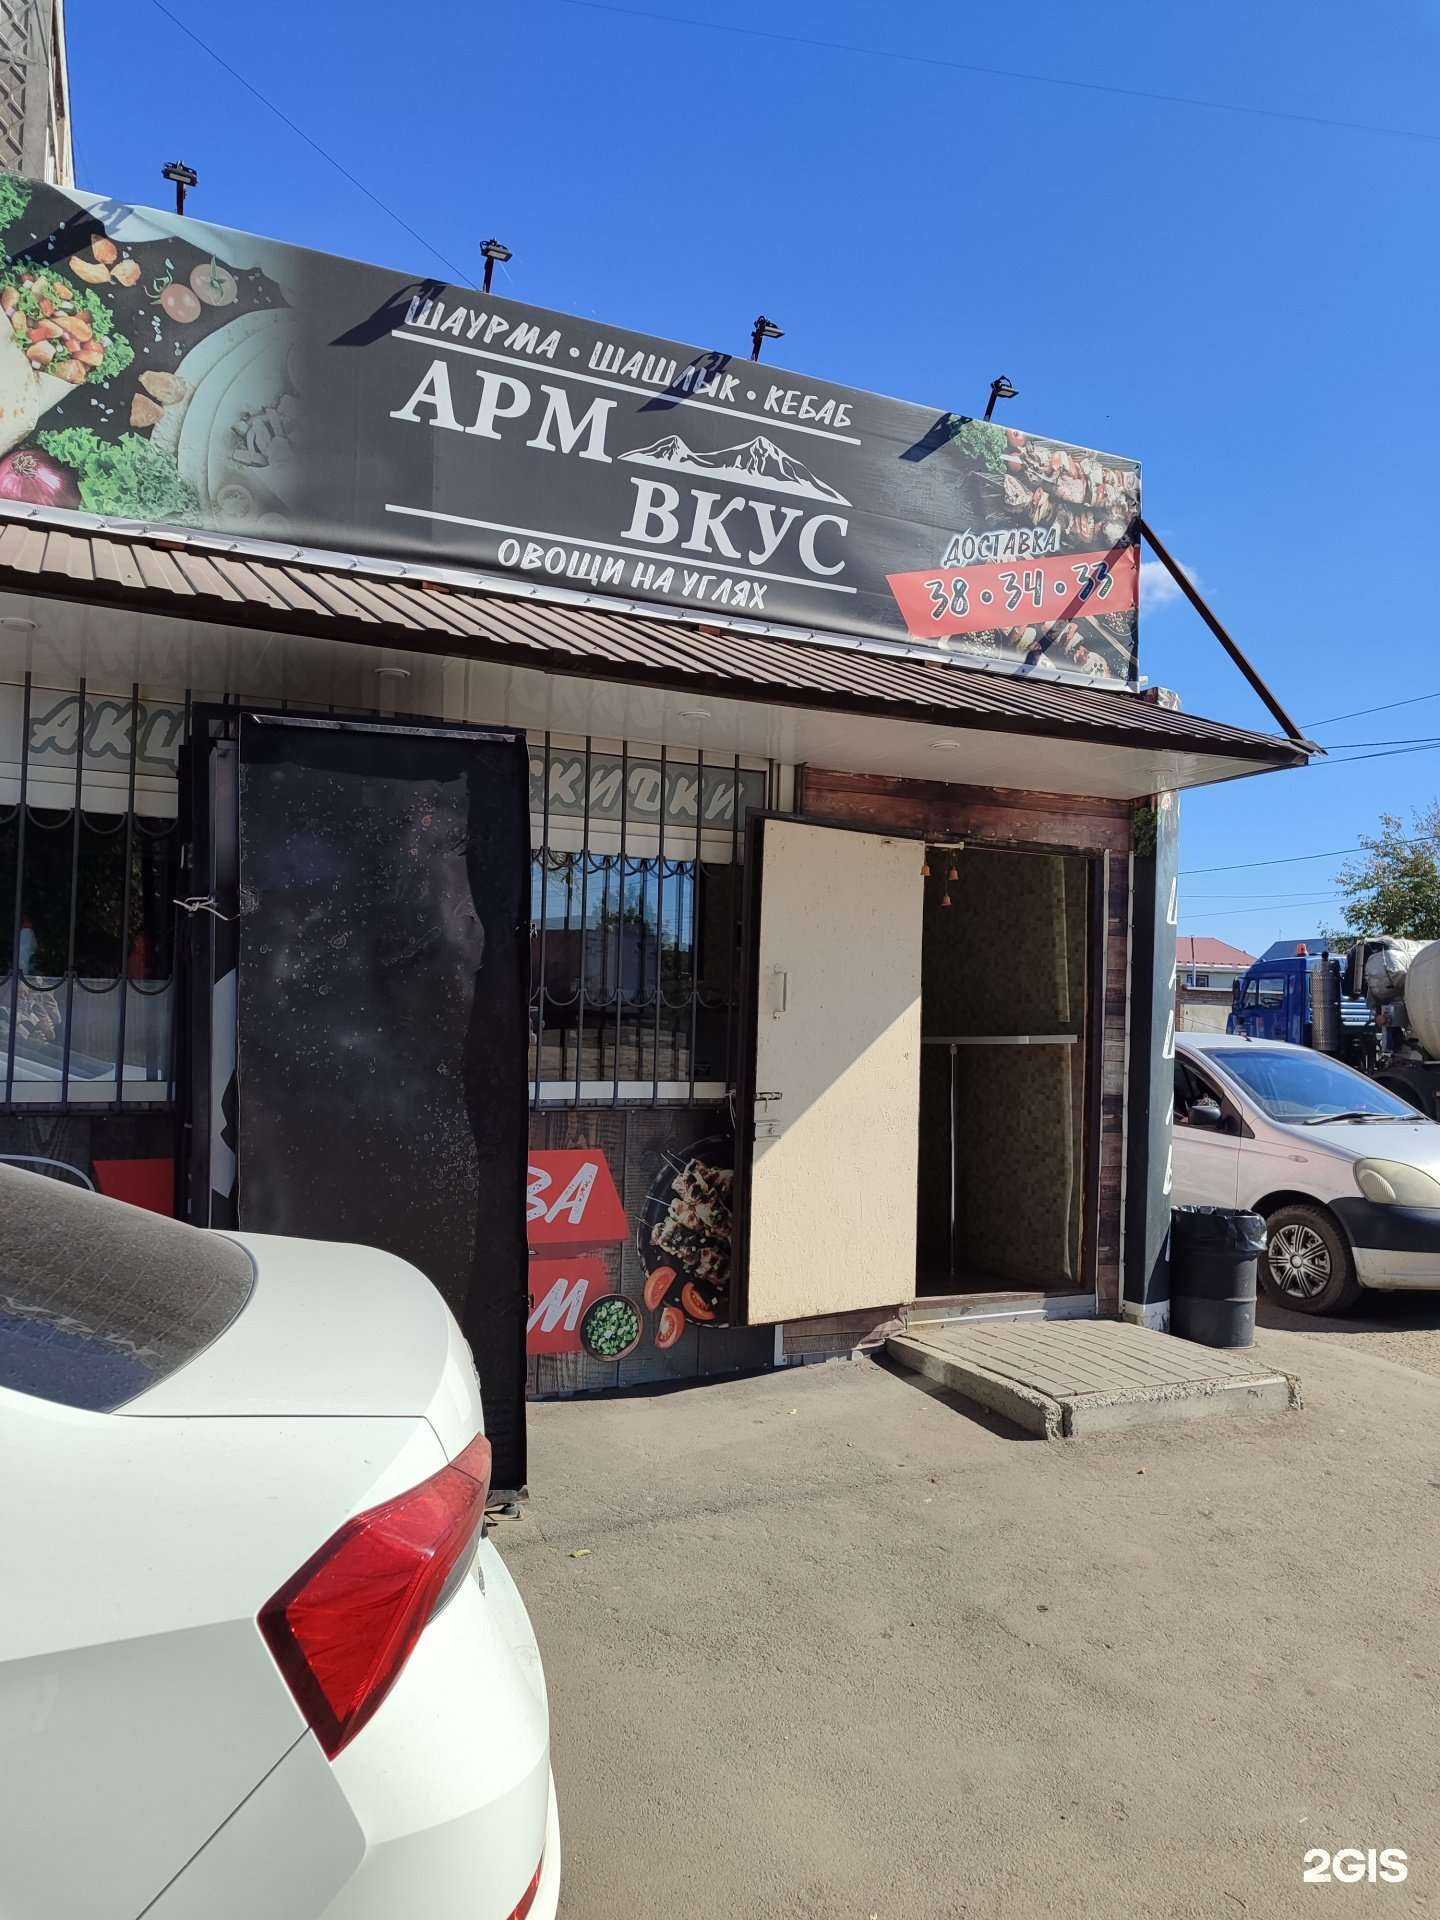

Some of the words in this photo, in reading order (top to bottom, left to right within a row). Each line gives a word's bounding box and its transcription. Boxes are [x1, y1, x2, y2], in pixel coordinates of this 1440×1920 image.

[389, 359, 618, 464] АРМ
[404, 295, 562, 359] ШАУРМА
[588, 341, 740, 402] ШАШЛЫК
[763, 384, 854, 428] КЕБАБ
[498, 538, 627, 587] ОВОЩИ
[630, 562, 673, 594] НА
[682, 574, 768, 610] УГЛЯХ
[620, 476, 849, 577] ВКУС
[942, 526, 1059, 568] ДОСТАВКА
